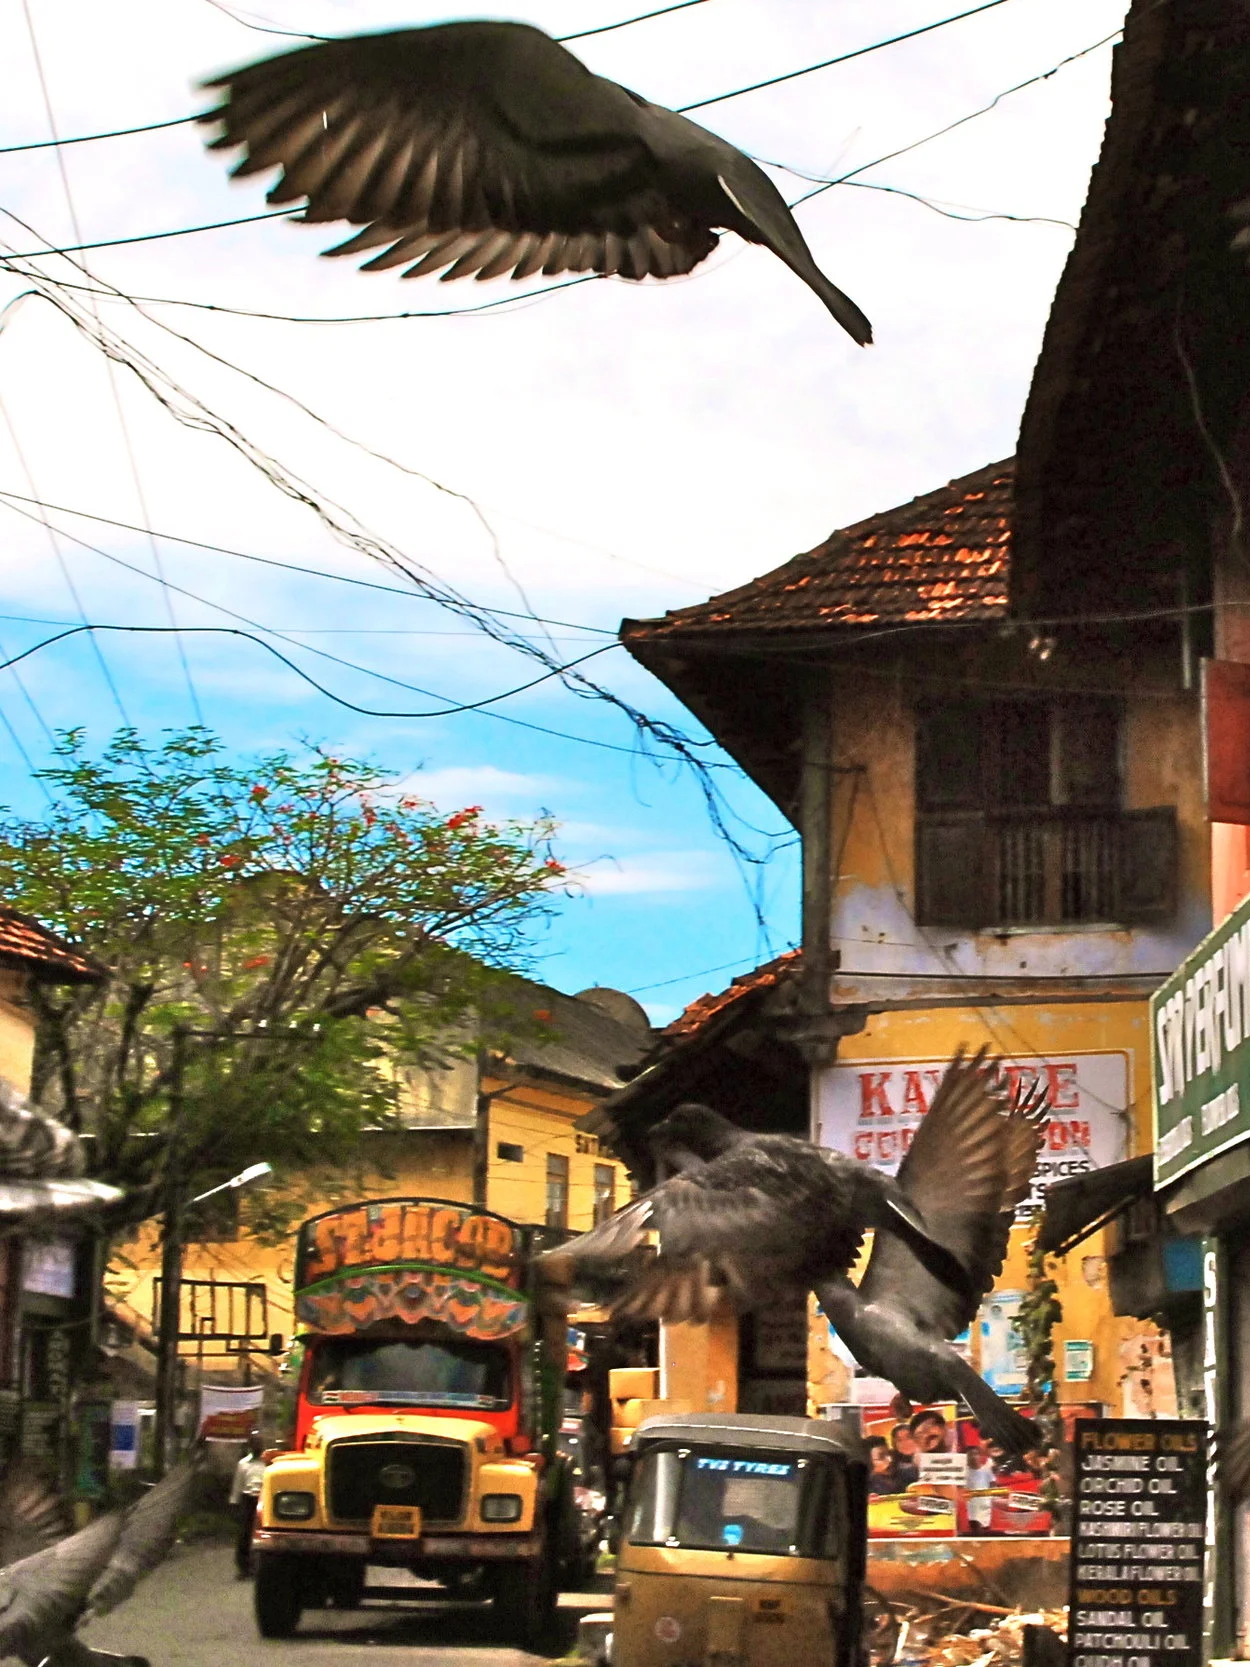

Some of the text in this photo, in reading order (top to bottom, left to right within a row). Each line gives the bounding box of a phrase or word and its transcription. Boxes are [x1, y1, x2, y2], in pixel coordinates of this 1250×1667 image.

[858, 1063, 1080, 1117] KAEE
[1081, 1432, 1197, 1451] FLOWER OILS
[1081, 1455, 1184, 1472] JASMINE OIL
[1080, 1477, 1178, 1494] ORCHID OIL
[1080, 1500, 1160, 1516] ROSE OIL
[1078, 1544, 1200, 1559] LOTUS FLOWER OIL
[1131, 1565, 1182, 1581] FLOWER
[1077, 1588, 1177, 1605] WOOD OILS
[1076, 1610, 1169, 1627] SANDAL OIL
[1074, 1633, 1191, 1649] PATCHOULI OIL
